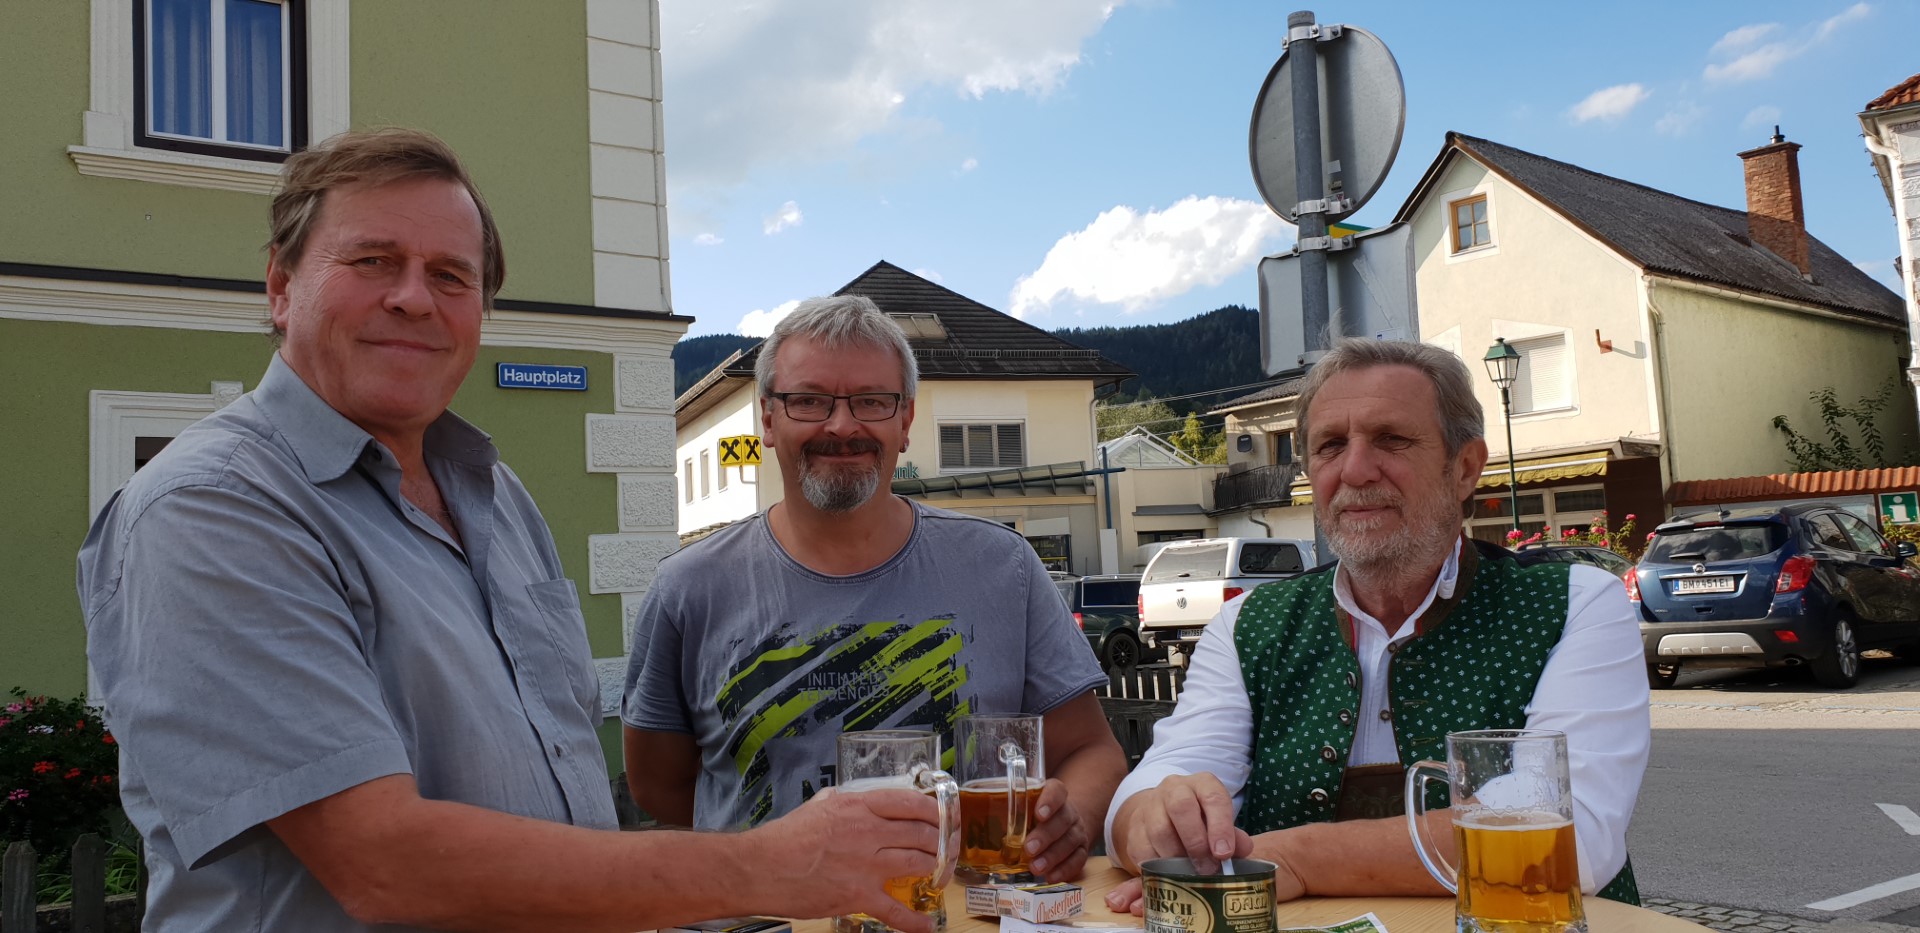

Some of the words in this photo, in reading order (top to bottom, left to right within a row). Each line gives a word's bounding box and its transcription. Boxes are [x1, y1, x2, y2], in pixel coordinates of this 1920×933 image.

[504, 368, 581, 385] Hauptplatz
[808, 671, 878, 686] INITIATED
[798, 685, 889, 700] TENDENCIES
[1146, 886, 1178, 901] RIND
